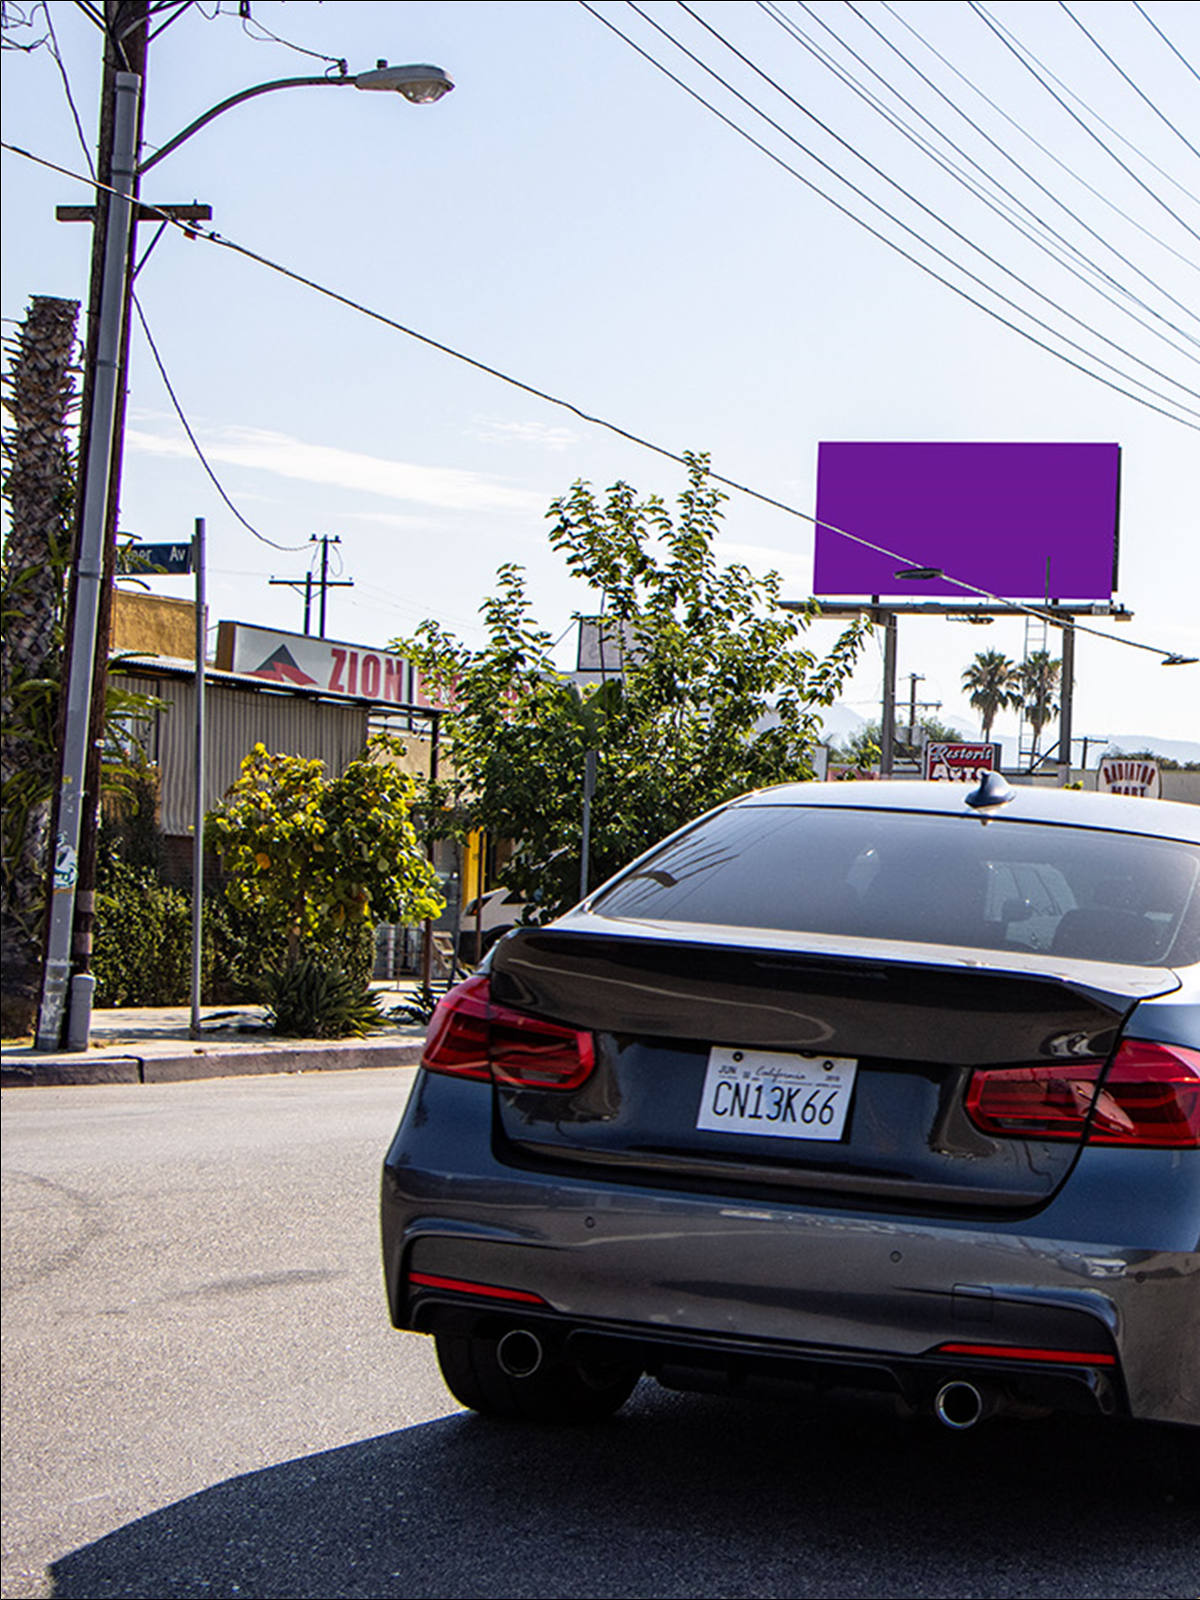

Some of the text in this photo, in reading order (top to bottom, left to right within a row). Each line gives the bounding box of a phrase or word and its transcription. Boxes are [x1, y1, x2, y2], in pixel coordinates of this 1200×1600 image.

[169, 545, 186, 562] Av
[328, 648, 403, 704] ZION
[1103, 762, 1156, 786] RADIATOR
[1111, 786, 1146, 798] MART
[755, 1065, 807, 1083] California
[712, 1080, 839, 1126] CN13K66
